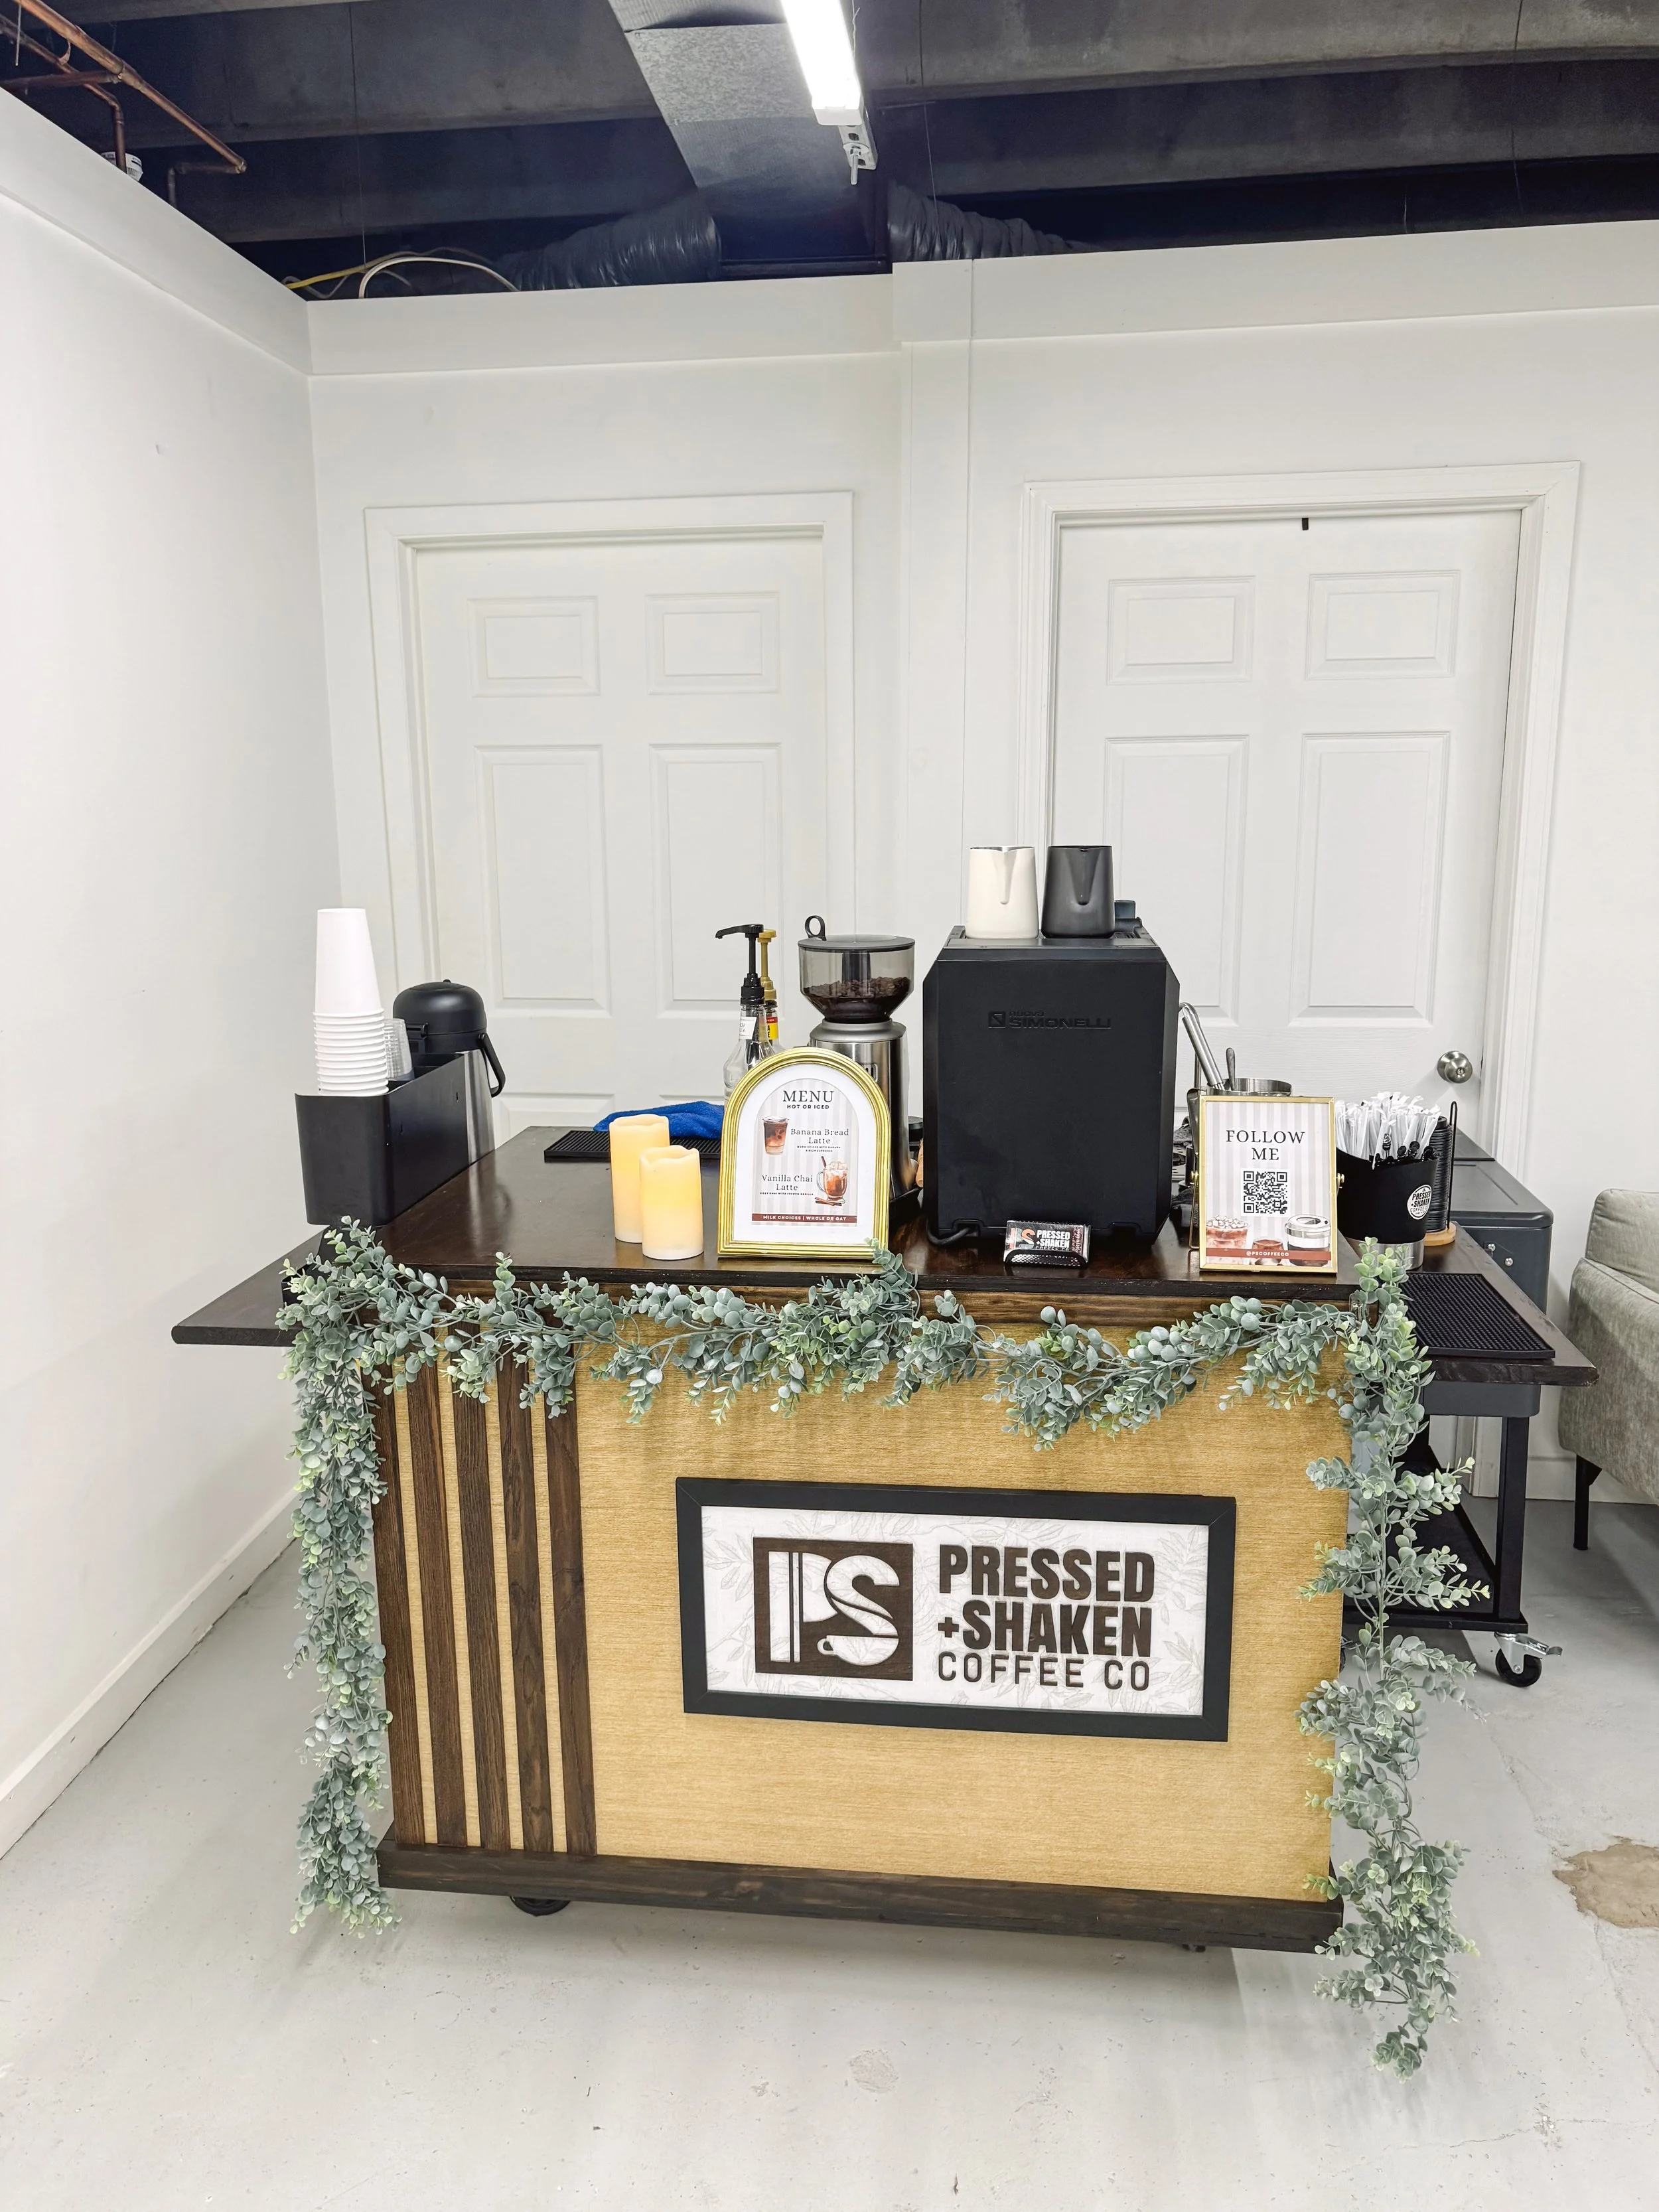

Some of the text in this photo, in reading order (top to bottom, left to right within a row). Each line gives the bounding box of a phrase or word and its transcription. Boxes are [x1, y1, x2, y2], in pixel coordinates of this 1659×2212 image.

[1009, 1017, 1112, 1029] SIMONELLI
[783, 1090, 834, 1102] MENU
[1226, 1130, 1305, 1143] FOLLOW
[1252, 1147, 1279, 1160] ME
[1037, 1230, 1070, 1240] PRESSED
[939, 1544, 1155, 1602] PRESSED
[938, 1651, 1149, 1691] COFFEE CO
